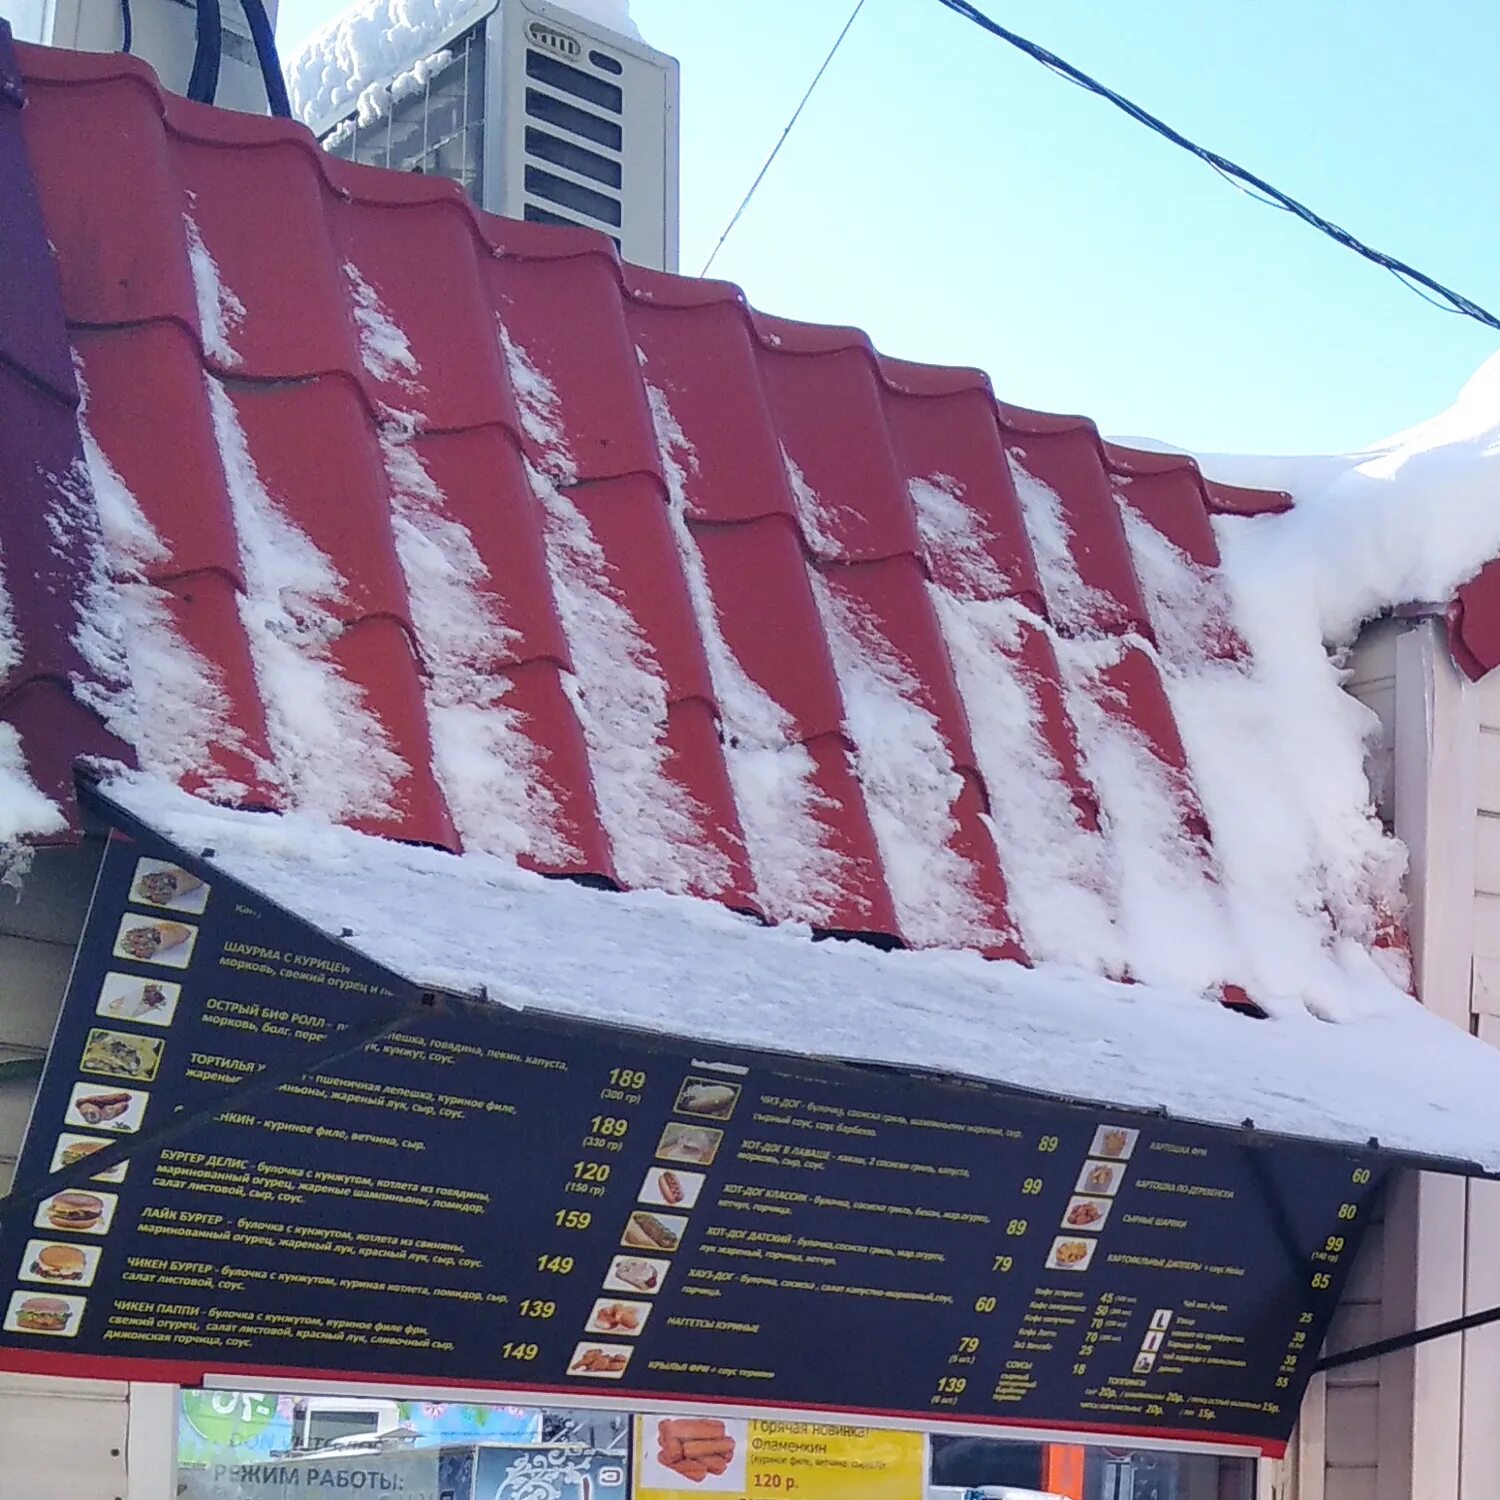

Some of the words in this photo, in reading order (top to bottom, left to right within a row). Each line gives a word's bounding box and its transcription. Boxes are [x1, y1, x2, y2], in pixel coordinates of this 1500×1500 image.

[223, 941, 280, 960] ШАУРМА
[219, 957, 276, 976] морковь,
[280, 968, 325, 983] свежий
[327, 978, 367, 993] огурец
[207, 998, 260, 1017] ОСТРЫЙ
[262, 1008, 289, 1022] БИФ
[291, 1014, 326, 1028] РОЛЛ
[202, 1014, 258, 1033] морковь,
[190, 1052, 255, 1073] ТОРТИЛЬЯ
[608, 1066, 646, 1090] 189
[264, 1120, 314, 1135] куриное
[590, 1114, 628, 1137] 189
[1038, 1135, 1059, 1153] 89
[160, 1149, 205, 1166] БУРГЕР
[206, 1155, 249, 1169] ДЕЛИС
[572, 1161, 611, 1184] 120
[1352, 1168, 1371, 1184] 60
[1021, 1178, 1044, 1196] 99
[141, 1206, 178, 1221] ЛАЙК
[179, 1211, 223, 1226] БУРГЕР
[554, 1209, 591, 1229] 159
[1337, 1203, 1357, 1220] 80
[137, 1223, 230, 1241] маринованный
[1007, 1219, 1028, 1237] 89
[1325, 1236, 1345, 1252] 99
[127, 1256, 168, 1270] ЧИКЕН
[169, 1261, 214, 1275] БУРГЕР
[537, 1255, 574, 1274] 149
[992, 1256, 1013, 1273] 79
[1312, 1273, 1331, 1289] 85
[114, 1299, 153, 1313] ЧИКЕН
[156, 1303, 200, 1317] ПАППИ
[519, 1300, 556, 1318] 139
[975, 1297, 996, 1313] 60
[502, 1342, 538, 1360] 149
[958, 1336, 980, 1353] 79
[937, 1377, 966, 1394] 139
[752, 1439, 827, 1454] Фламенкин
[214, 1465, 300, 1485] РЕЖИМ
[307, 1468, 404, 1490] РАБОТЫ:
[754, 1474, 781, 1488] 120
[787, 1477, 798, 1491] р.
